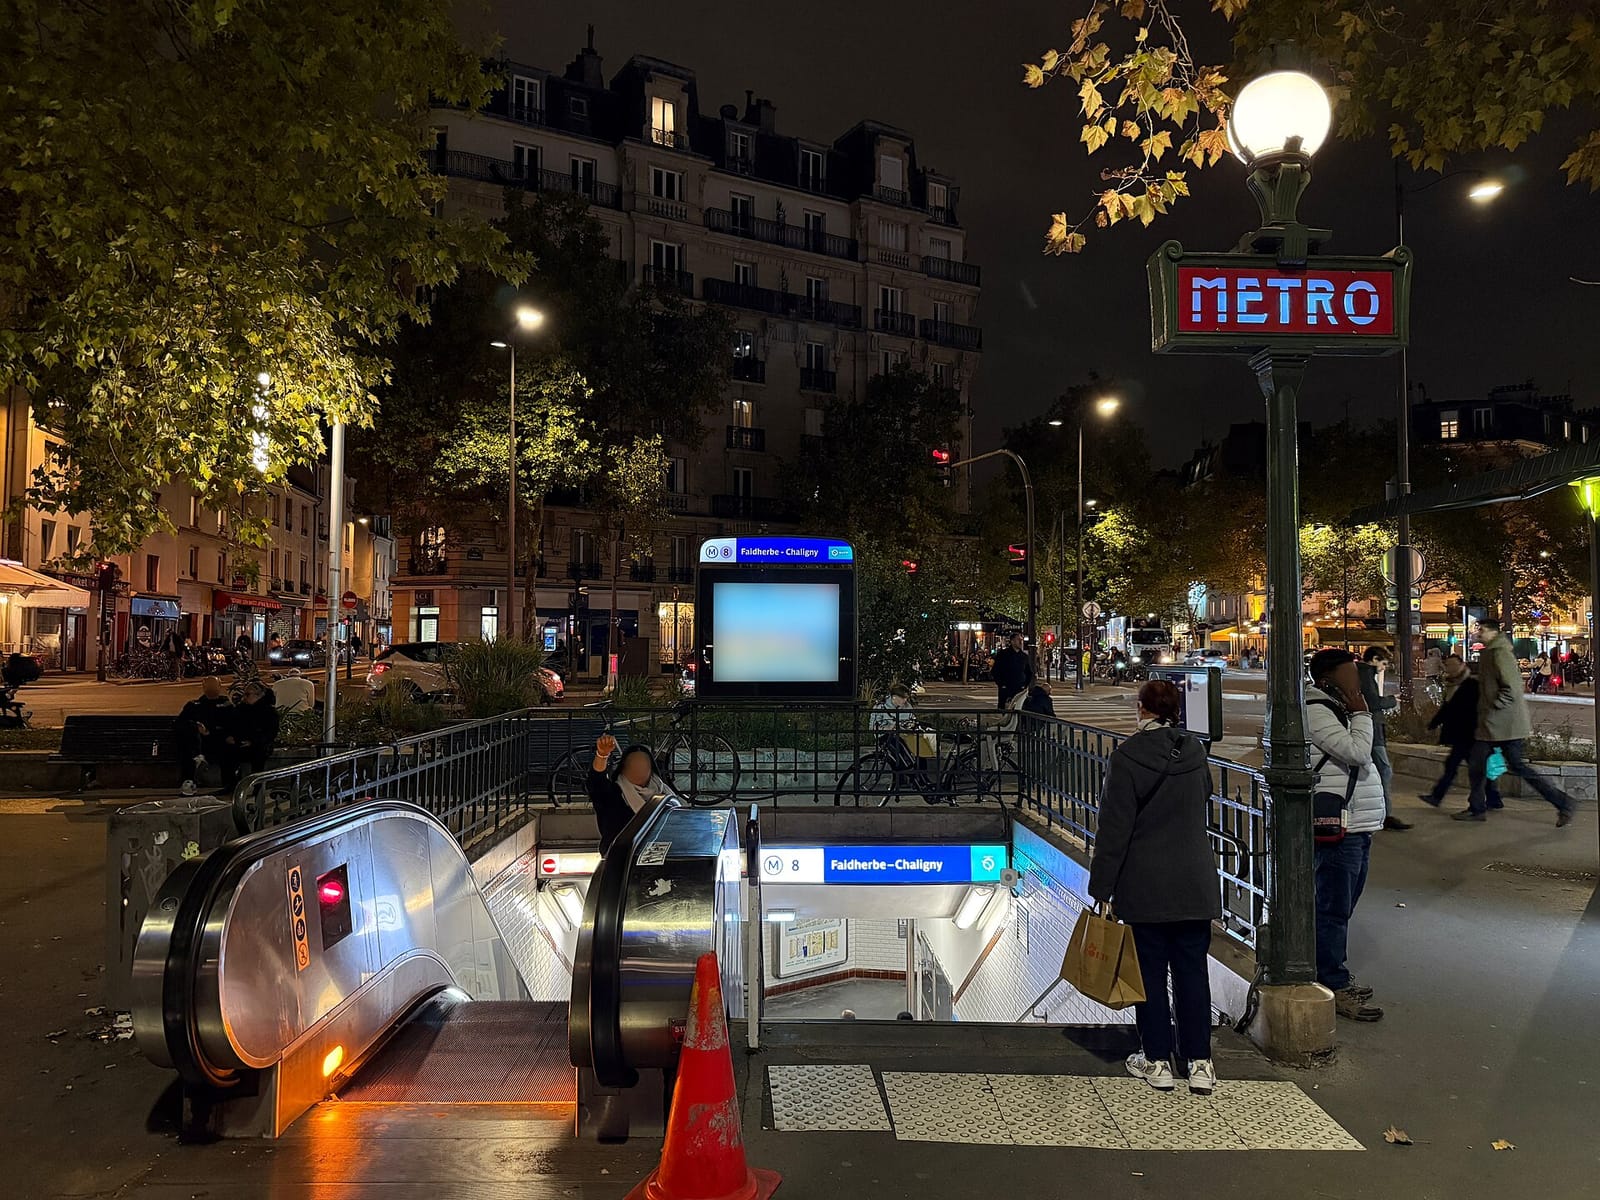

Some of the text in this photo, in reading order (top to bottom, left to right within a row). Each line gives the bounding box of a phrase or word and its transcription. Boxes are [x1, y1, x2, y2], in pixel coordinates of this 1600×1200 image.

[1191, 276, 1380, 325] METRO
[741, 547, 779, 556] Faidherbe
[785, 547, 819, 558] Chaligny
[791, 859, 800, 871] 8
